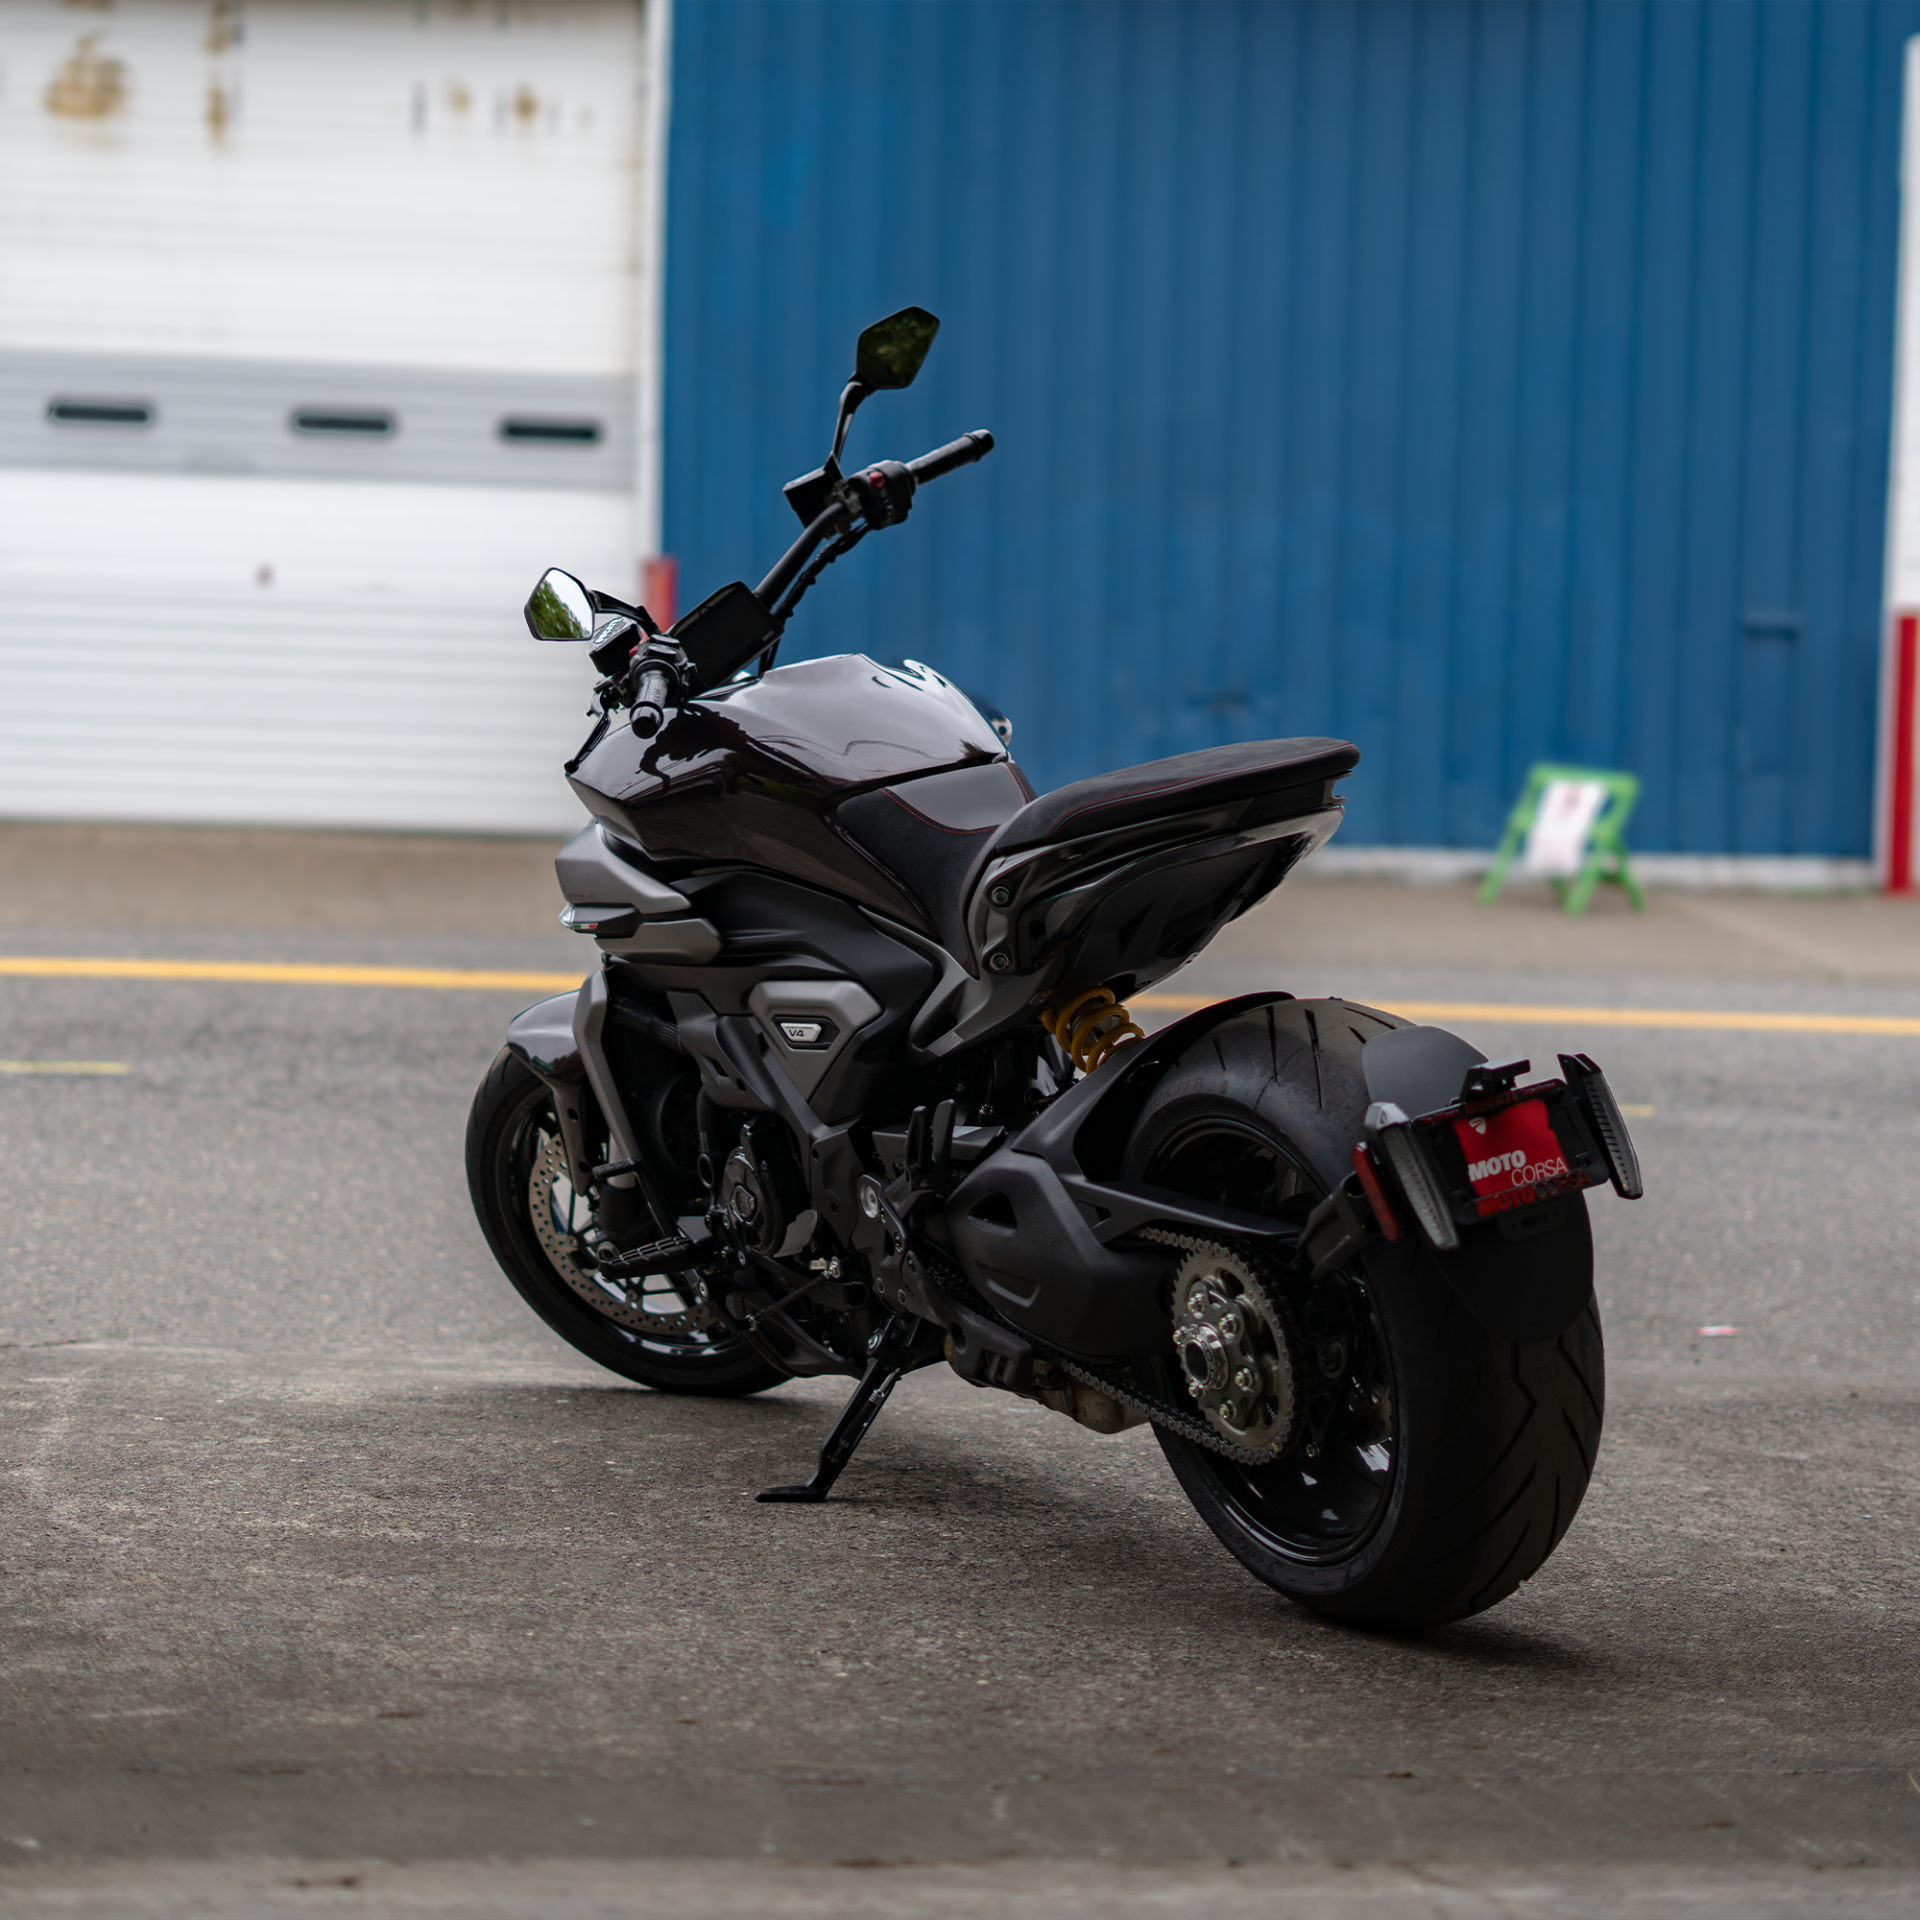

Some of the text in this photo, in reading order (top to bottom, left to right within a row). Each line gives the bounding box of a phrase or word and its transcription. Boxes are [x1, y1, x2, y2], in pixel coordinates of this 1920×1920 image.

[788, 1029, 805, 1038] V4
[1468, 1150, 1526, 1182] MOTO
[1511, 1157, 1568, 1187] CORSA
